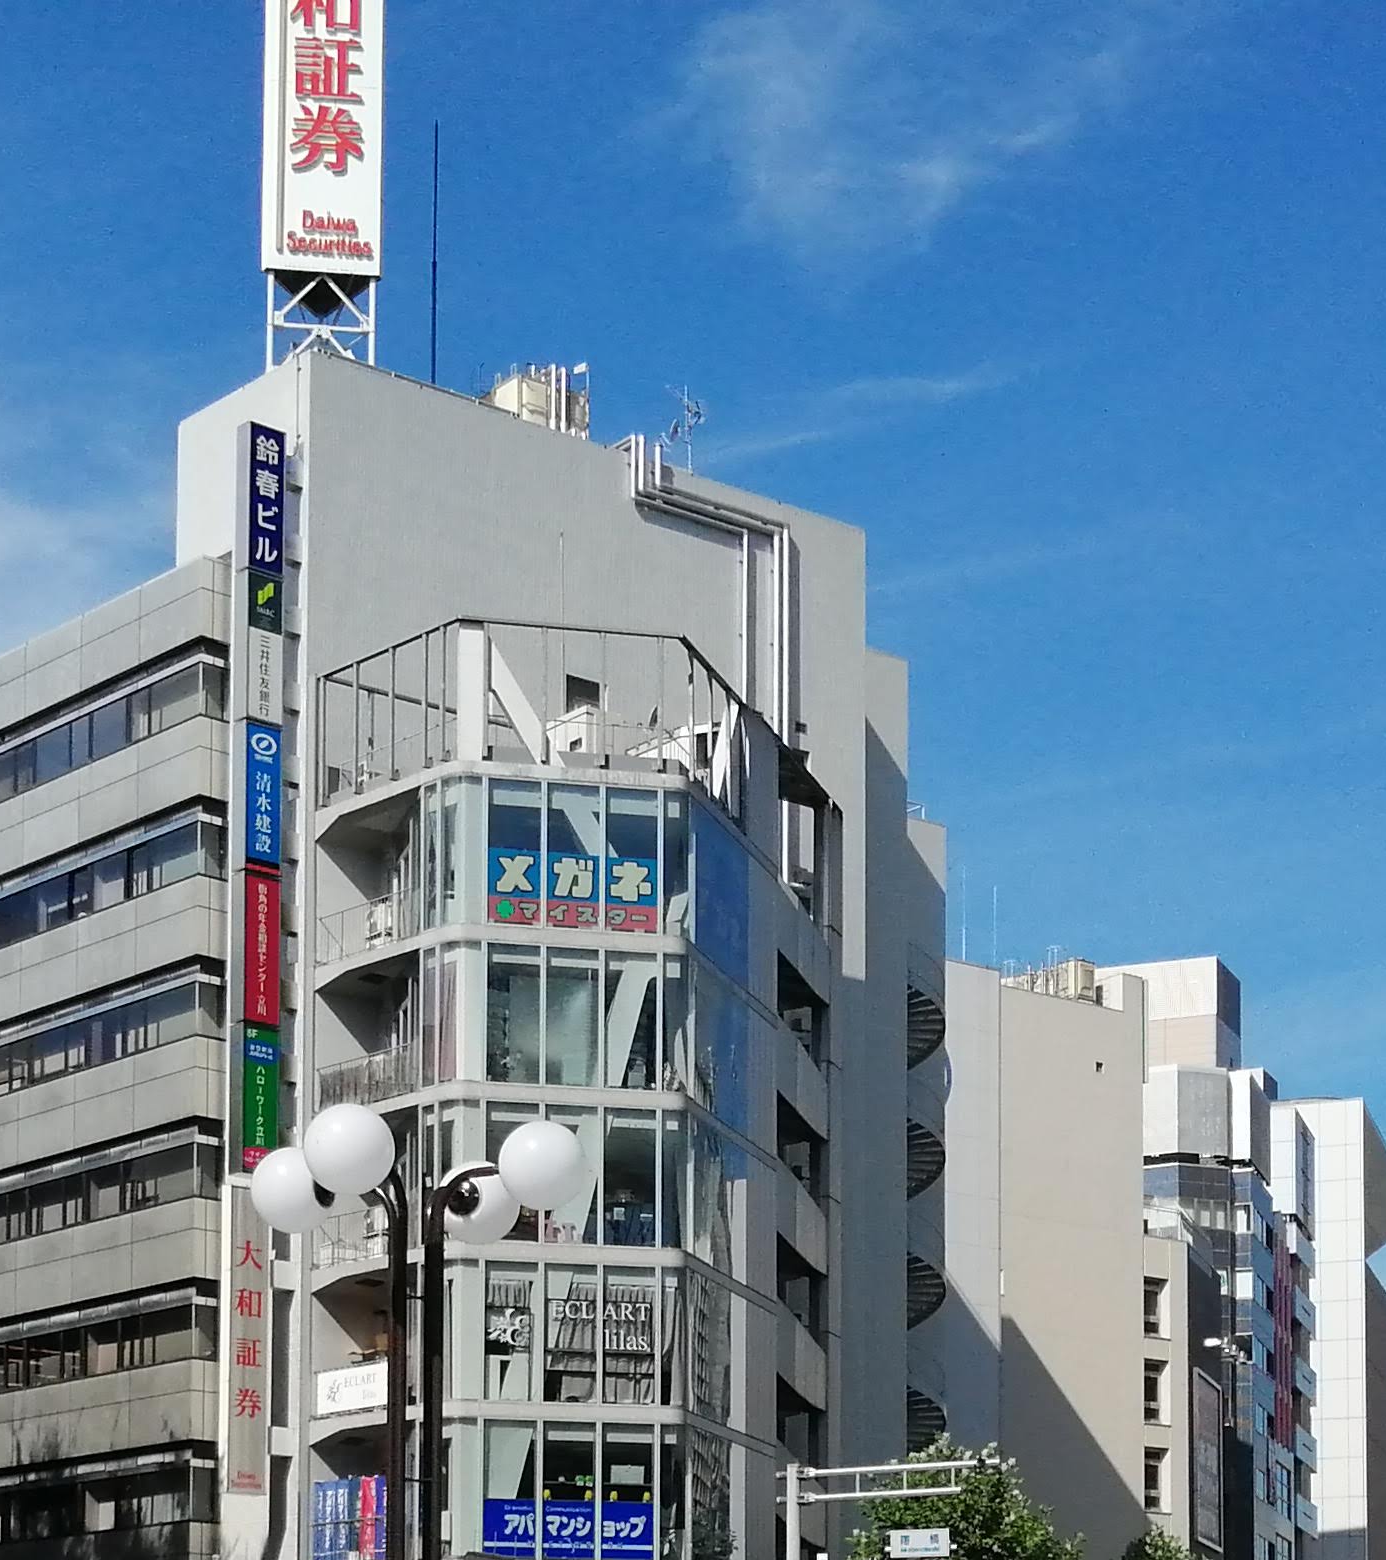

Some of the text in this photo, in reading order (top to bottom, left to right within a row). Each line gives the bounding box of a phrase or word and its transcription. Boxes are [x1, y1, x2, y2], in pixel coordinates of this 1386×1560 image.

[286, 232, 374, 258] Securities
[301, 210, 358, 234] Daiwa
[253, 434, 279, 563] 鈴春ビル
[259, 634, 272, 718] 三井住友銀行
[254, 770, 273, 854] 清水建設
[496, 855, 652, 902] メガネ
[518, 902, 649, 925] マイスター
[255, 1065, 266, 1147] ハローワーク立川
[235, 1239, 263, 1420] 大和証券
[603, 1329, 648, 1351] lilas
[503, 1512, 647, 1538] アパマンショップ
